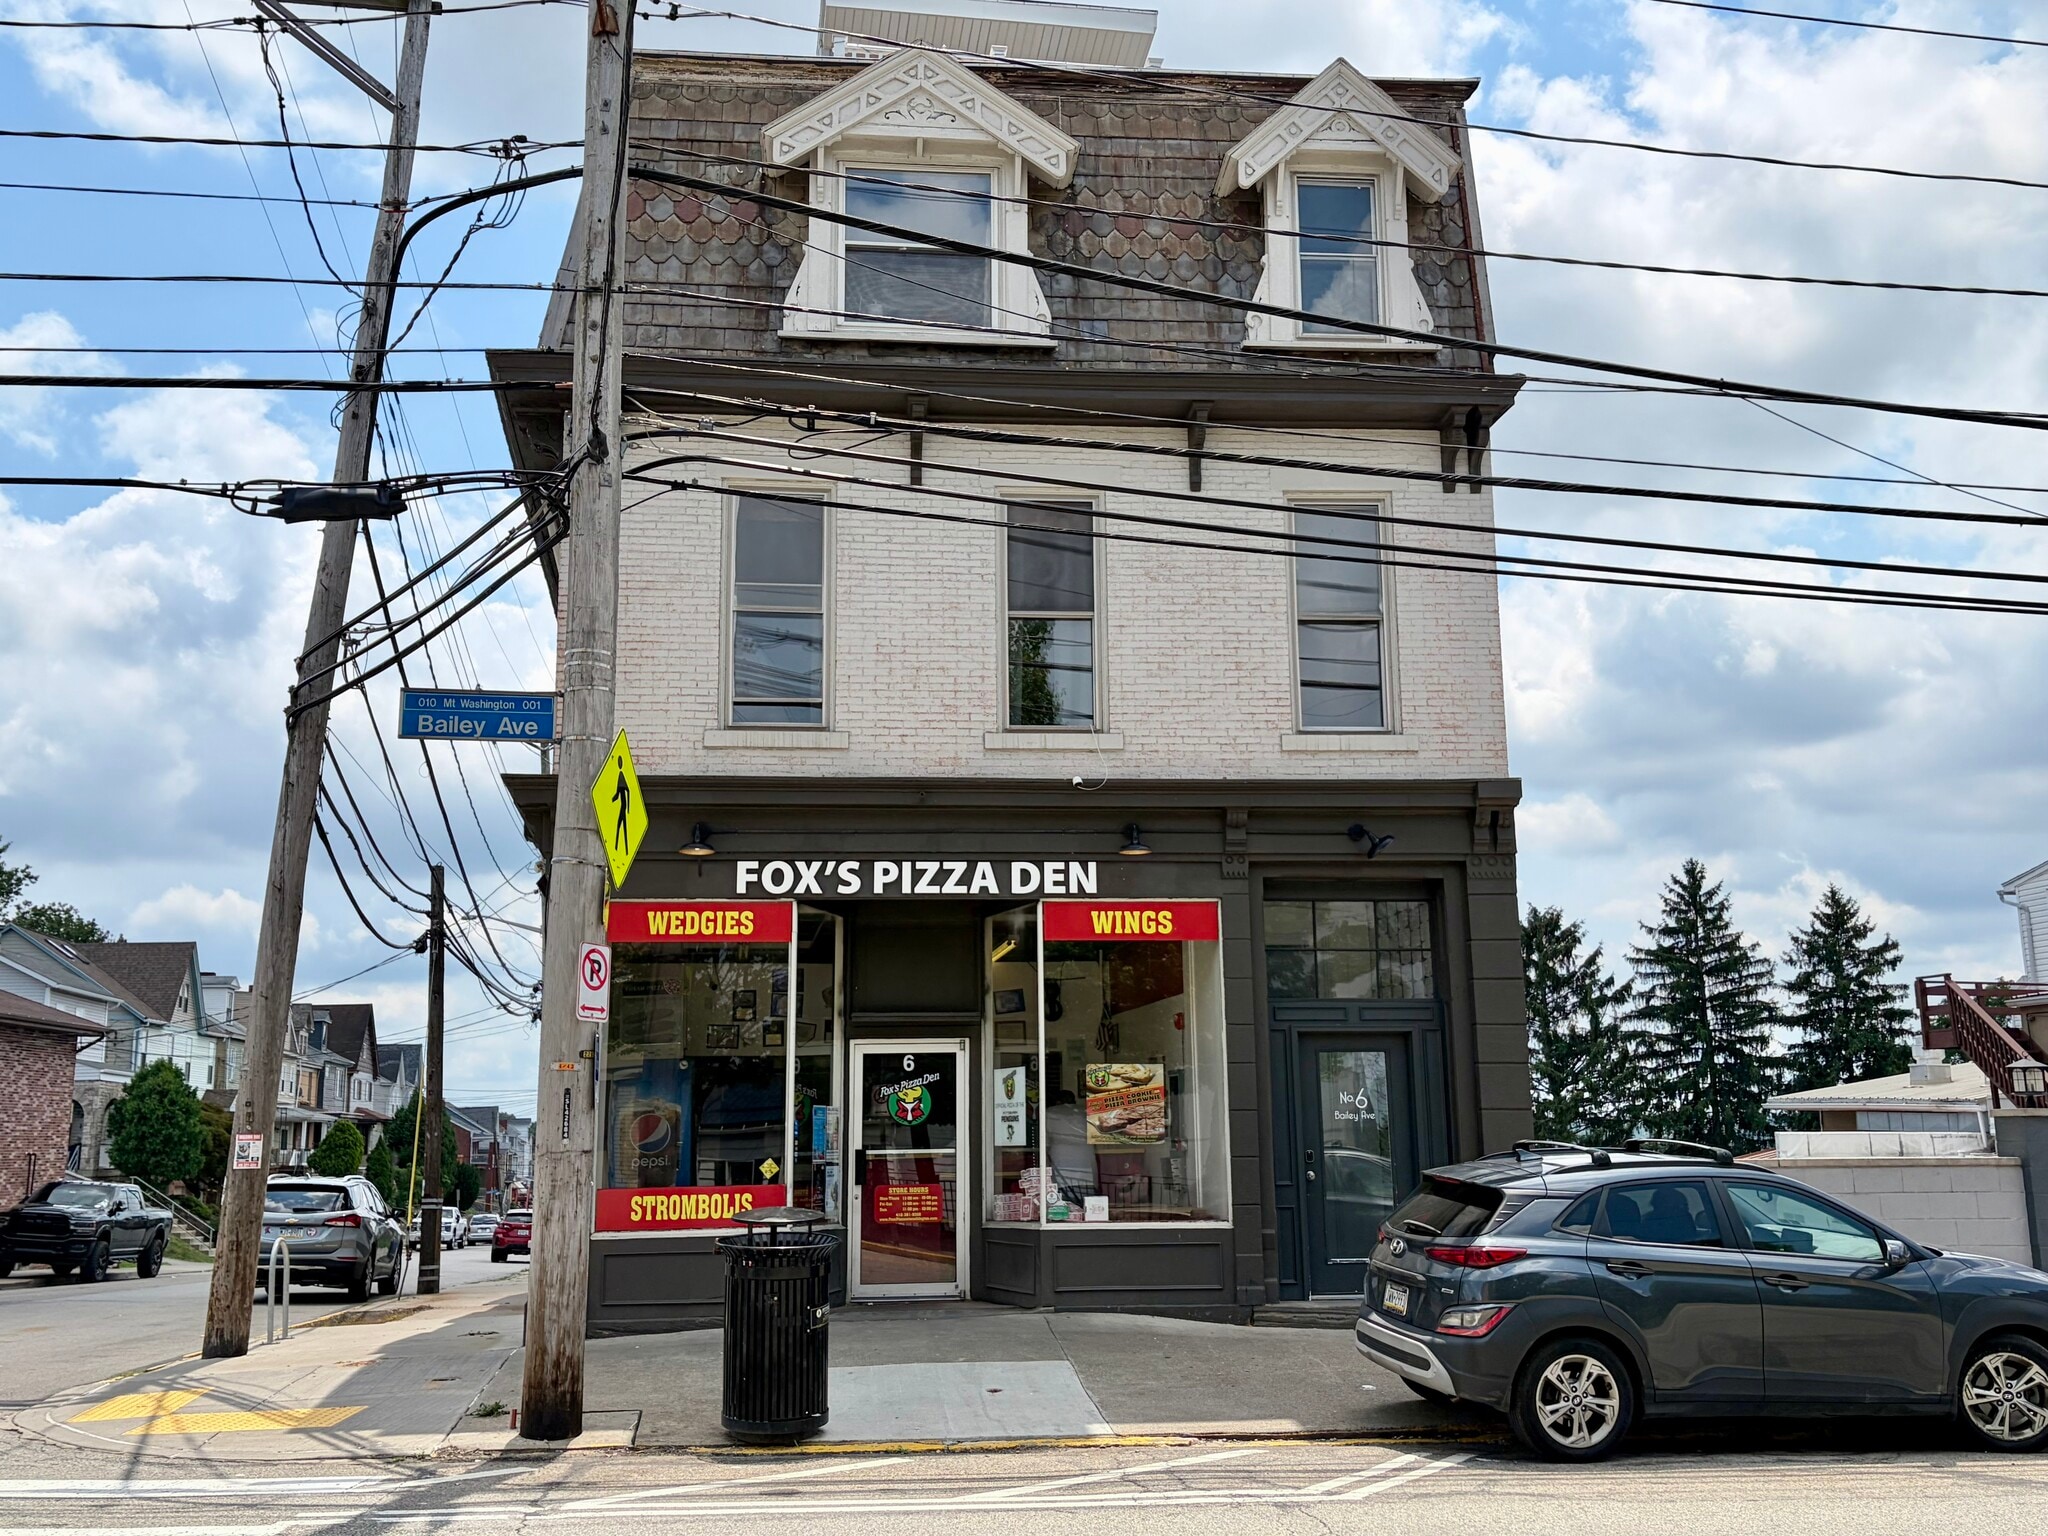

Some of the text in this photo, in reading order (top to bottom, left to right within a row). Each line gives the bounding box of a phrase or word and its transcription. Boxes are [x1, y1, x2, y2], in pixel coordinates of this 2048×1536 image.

[418, 697, 541, 711] 010 Mt Washington 001
[418, 715, 539, 737] Bailey Ave
[736, 860, 1098, 895] FOX'S PIZZA DEN
[647, 910, 754, 935] WEDGIES
[1090, 910, 1173, 934] WINGS
[903, 1054, 915, 1072] 6
[880, 1072, 940, 1098] Fox's Pizza Den
[1126, 1089, 1153, 1099] COOKIE
[1105, 1101, 1125, 1109] PIZZA
[1127, 1094, 1161, 1105] BROWNIE
[1355, 1088, 1368, 1109] 6
[1334, 1110, 1376, 1122] Bailey Ave
[631, 1155, 669, 1169] pepsi
[630, 1192, 753, 1222] STROMBOLIS
